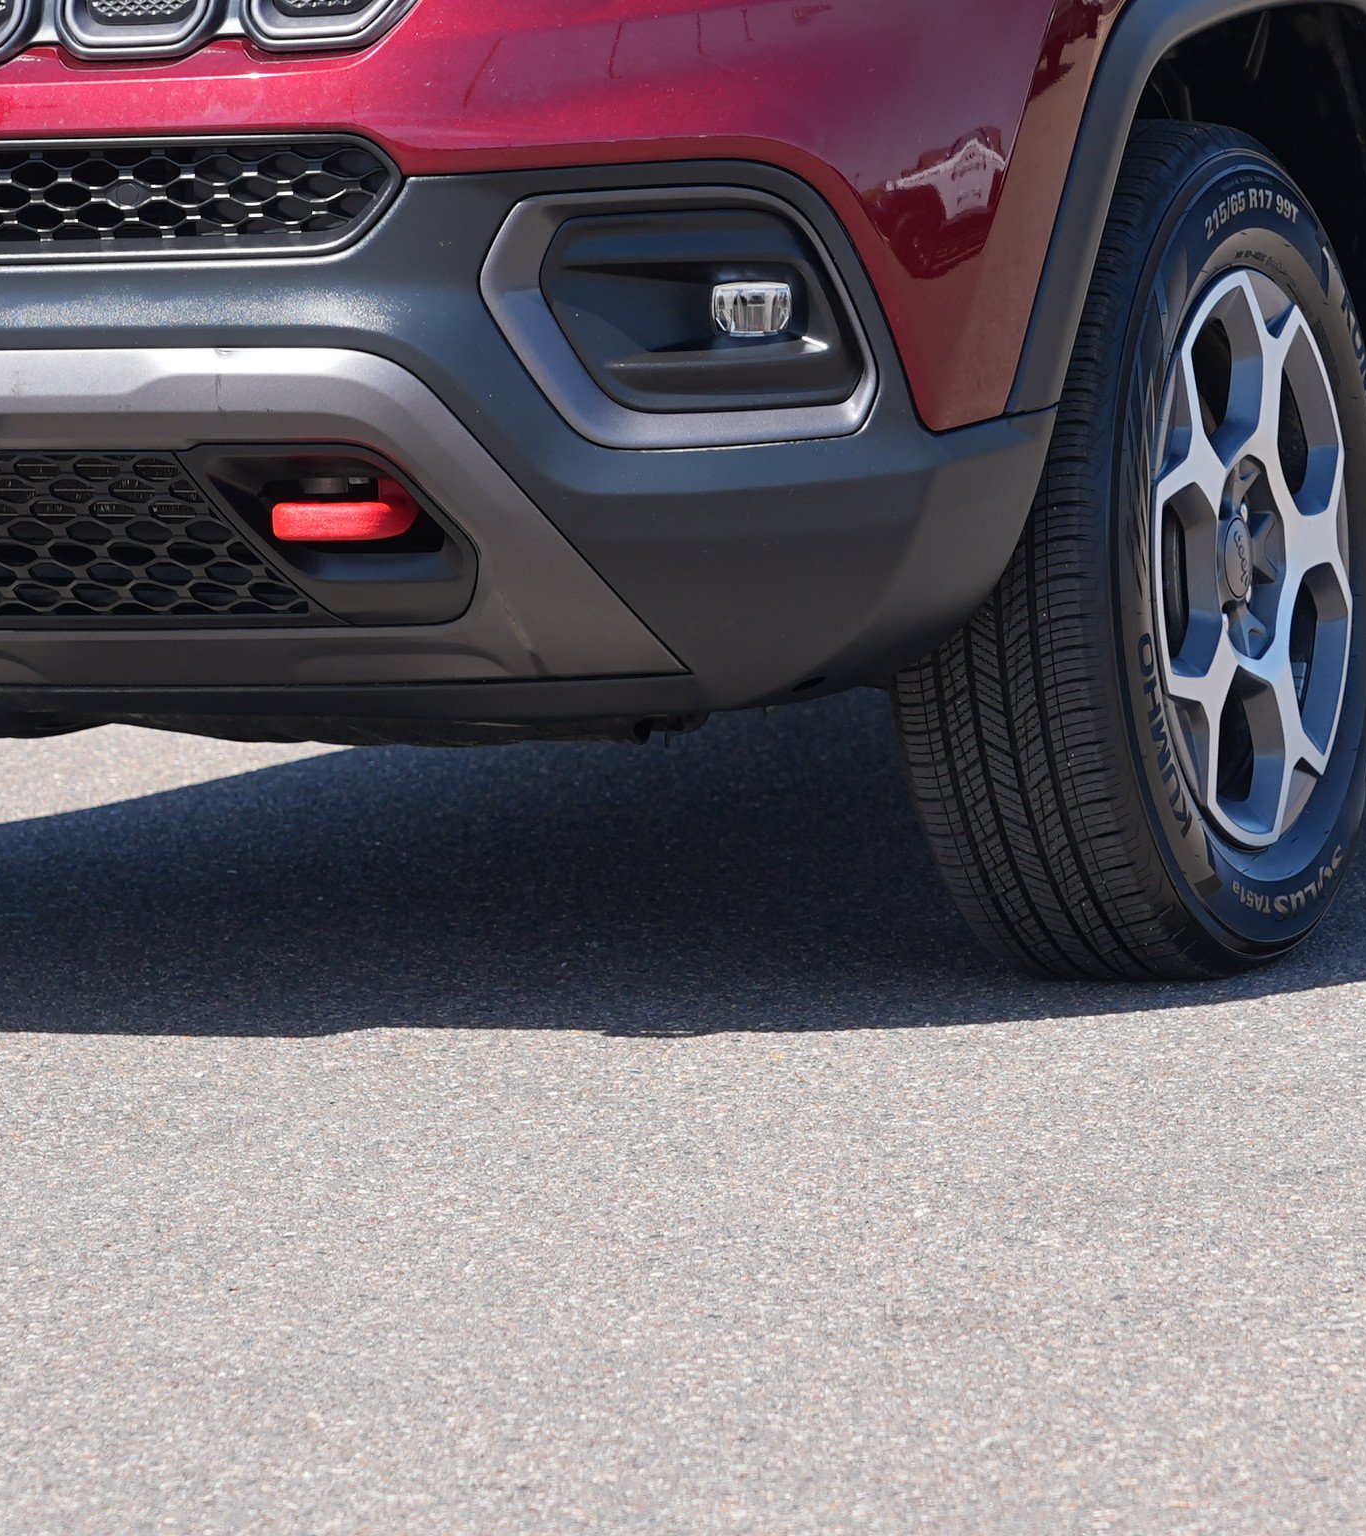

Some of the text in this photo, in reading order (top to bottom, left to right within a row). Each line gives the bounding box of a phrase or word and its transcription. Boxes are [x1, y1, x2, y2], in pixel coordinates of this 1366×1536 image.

[1204, 187, 1300, 241] 215/65 R17 99T
[1138, 632, 1193, 839] KUMHO
[1231, 879, 1272, 915] TA51a
